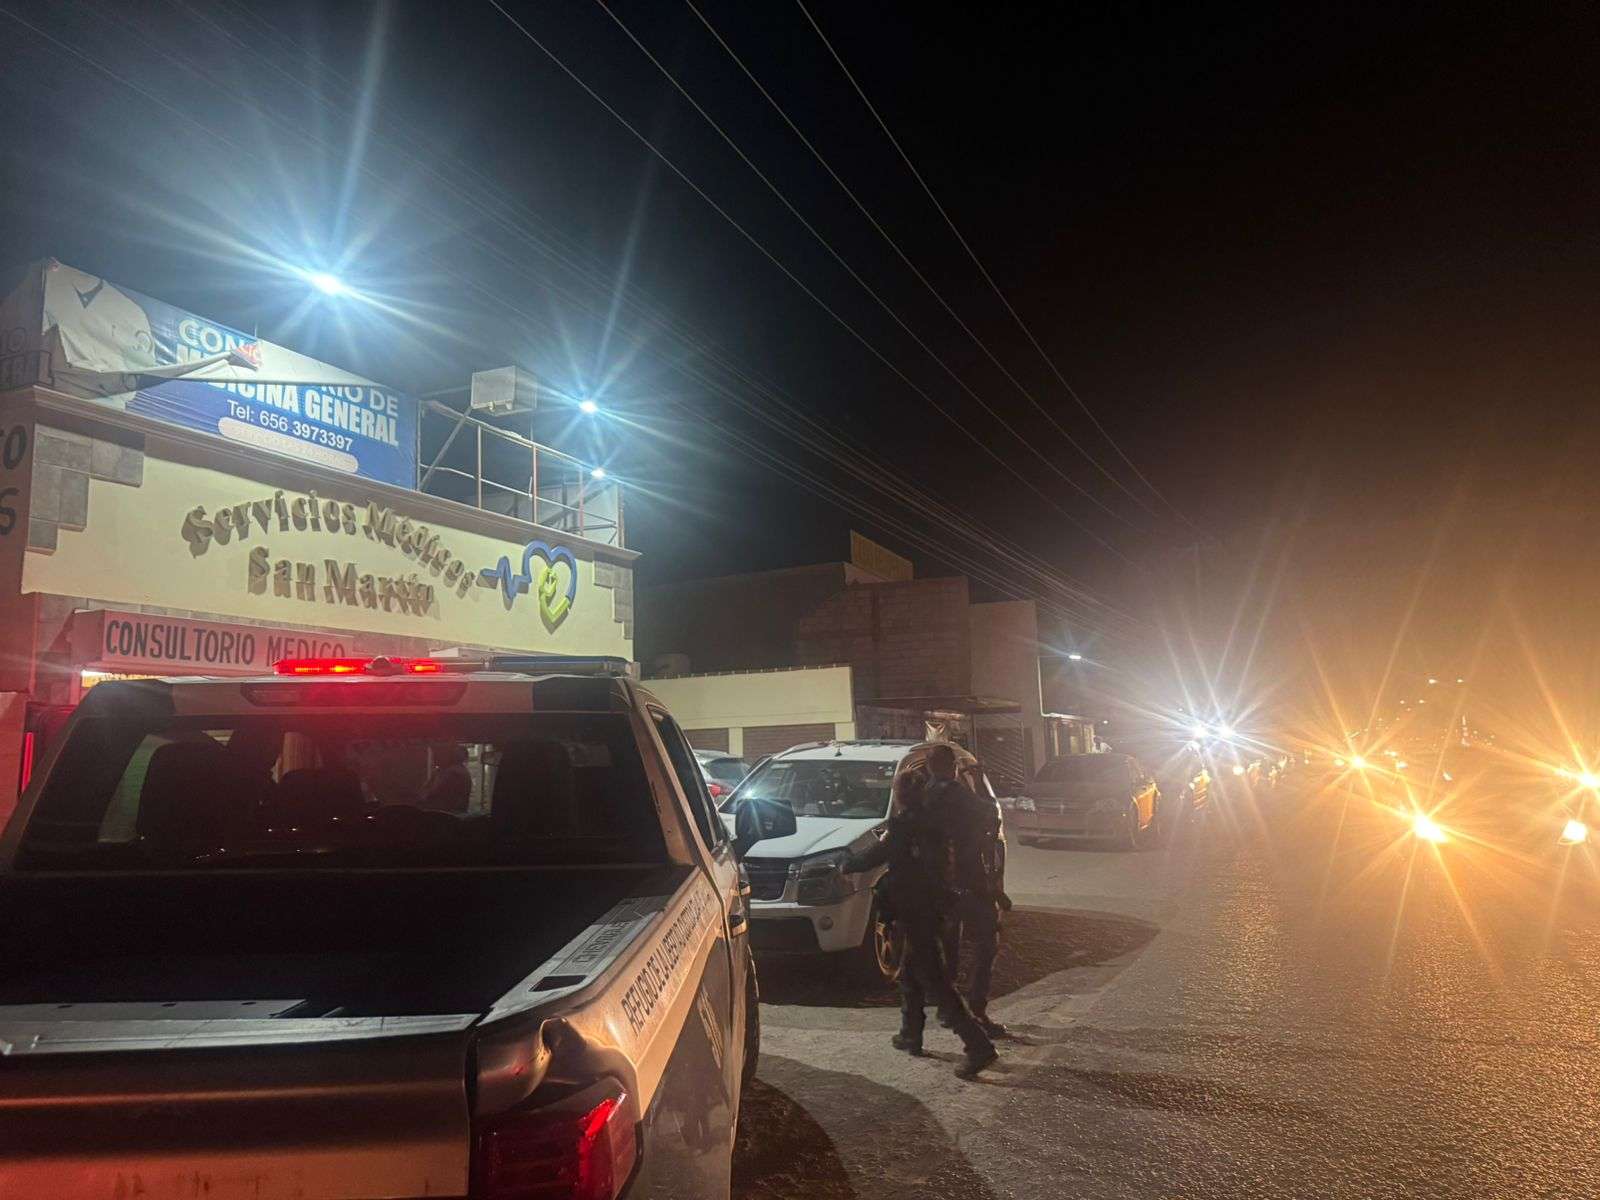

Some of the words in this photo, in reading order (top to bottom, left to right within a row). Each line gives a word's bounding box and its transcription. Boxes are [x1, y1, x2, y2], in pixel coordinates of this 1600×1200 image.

[227, 399, 254, 422] Tel:
[258, 410, 287, 431] 656
[292, 421, 353, 452] 3973397
[305, 389, 399, 446] GENERAL
[370, 388, 398, 417] DE
[182, 489, 357, 554] Servicios
[248, 546, 316, 598] San
[106, 619, 255, 667] CONSULTORIO
[266, 635, 345, 667] MEDICO
[621, 967, 657, 1038] REFUGIO
[646, 955, 665, 993] DE
